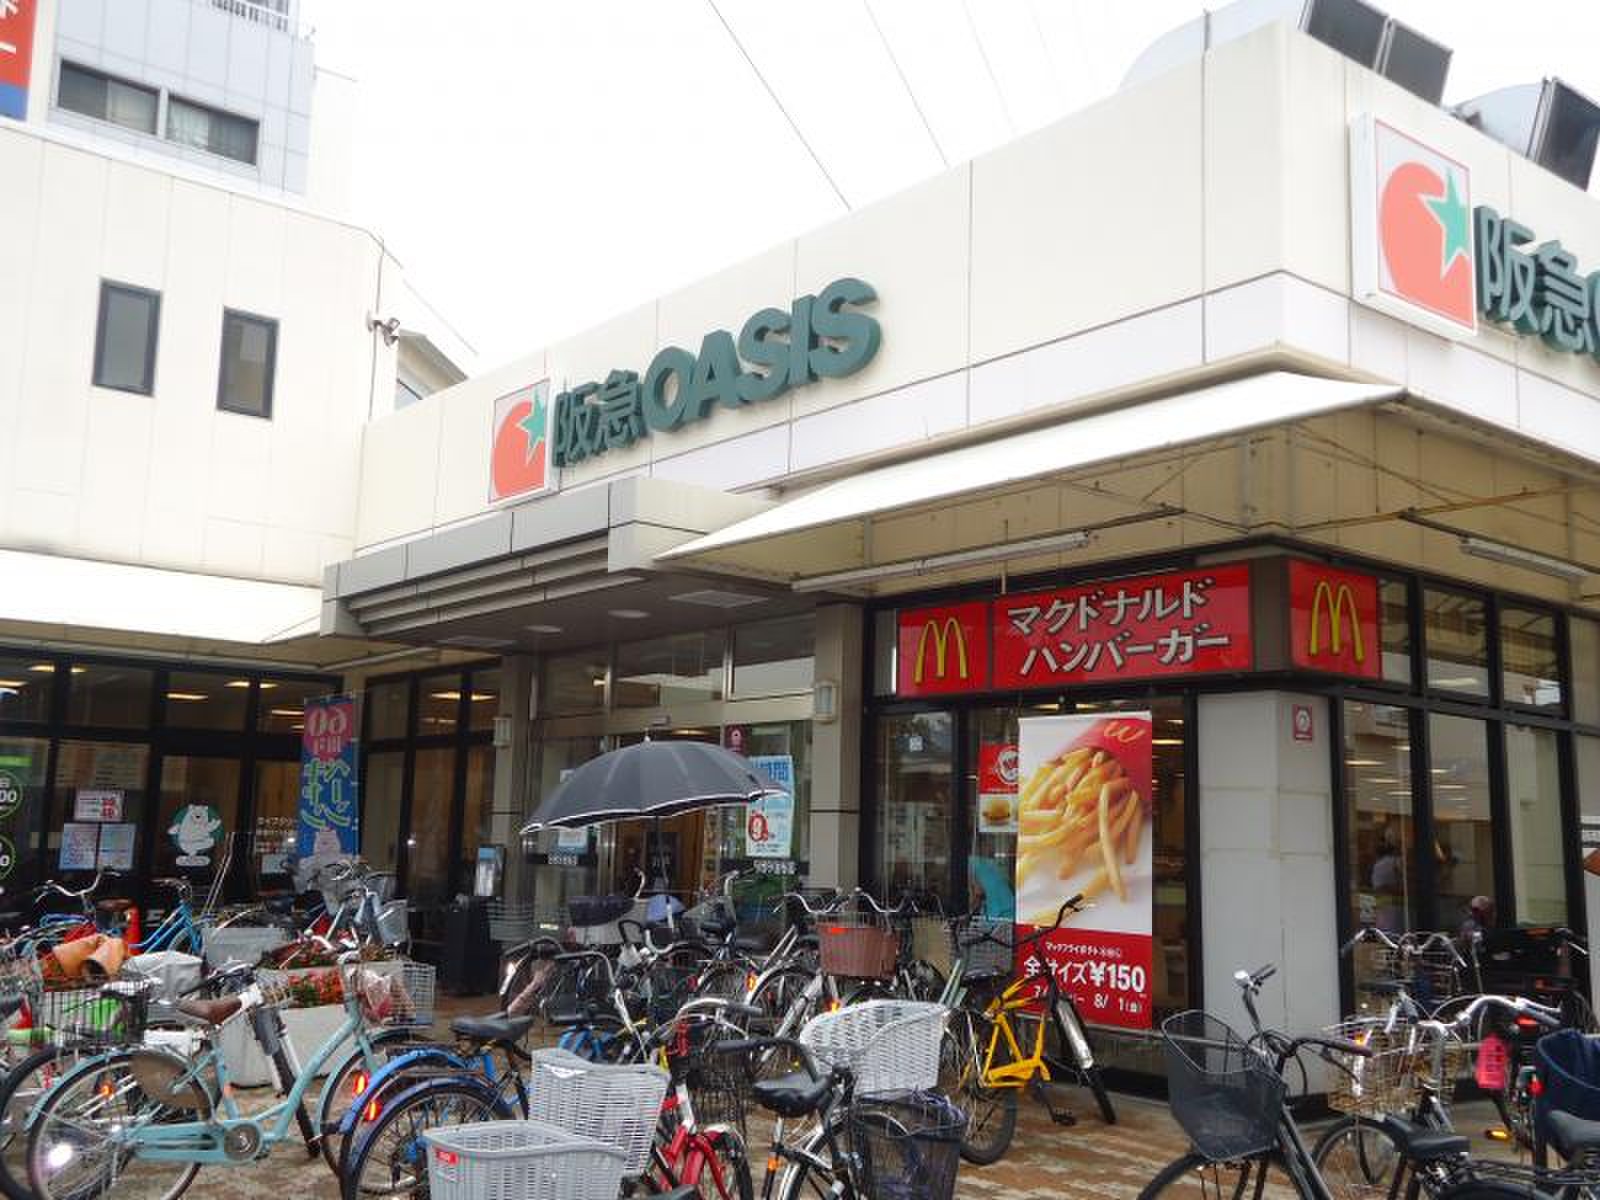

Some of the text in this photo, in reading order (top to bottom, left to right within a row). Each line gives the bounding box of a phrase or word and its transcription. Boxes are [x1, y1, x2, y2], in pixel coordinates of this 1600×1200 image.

[1473, 205, 1600, 367] 阪急
[1007, 577, 1214, 637] マクドナルド
[1020, 623, 1230, 676] ハンバーガー
